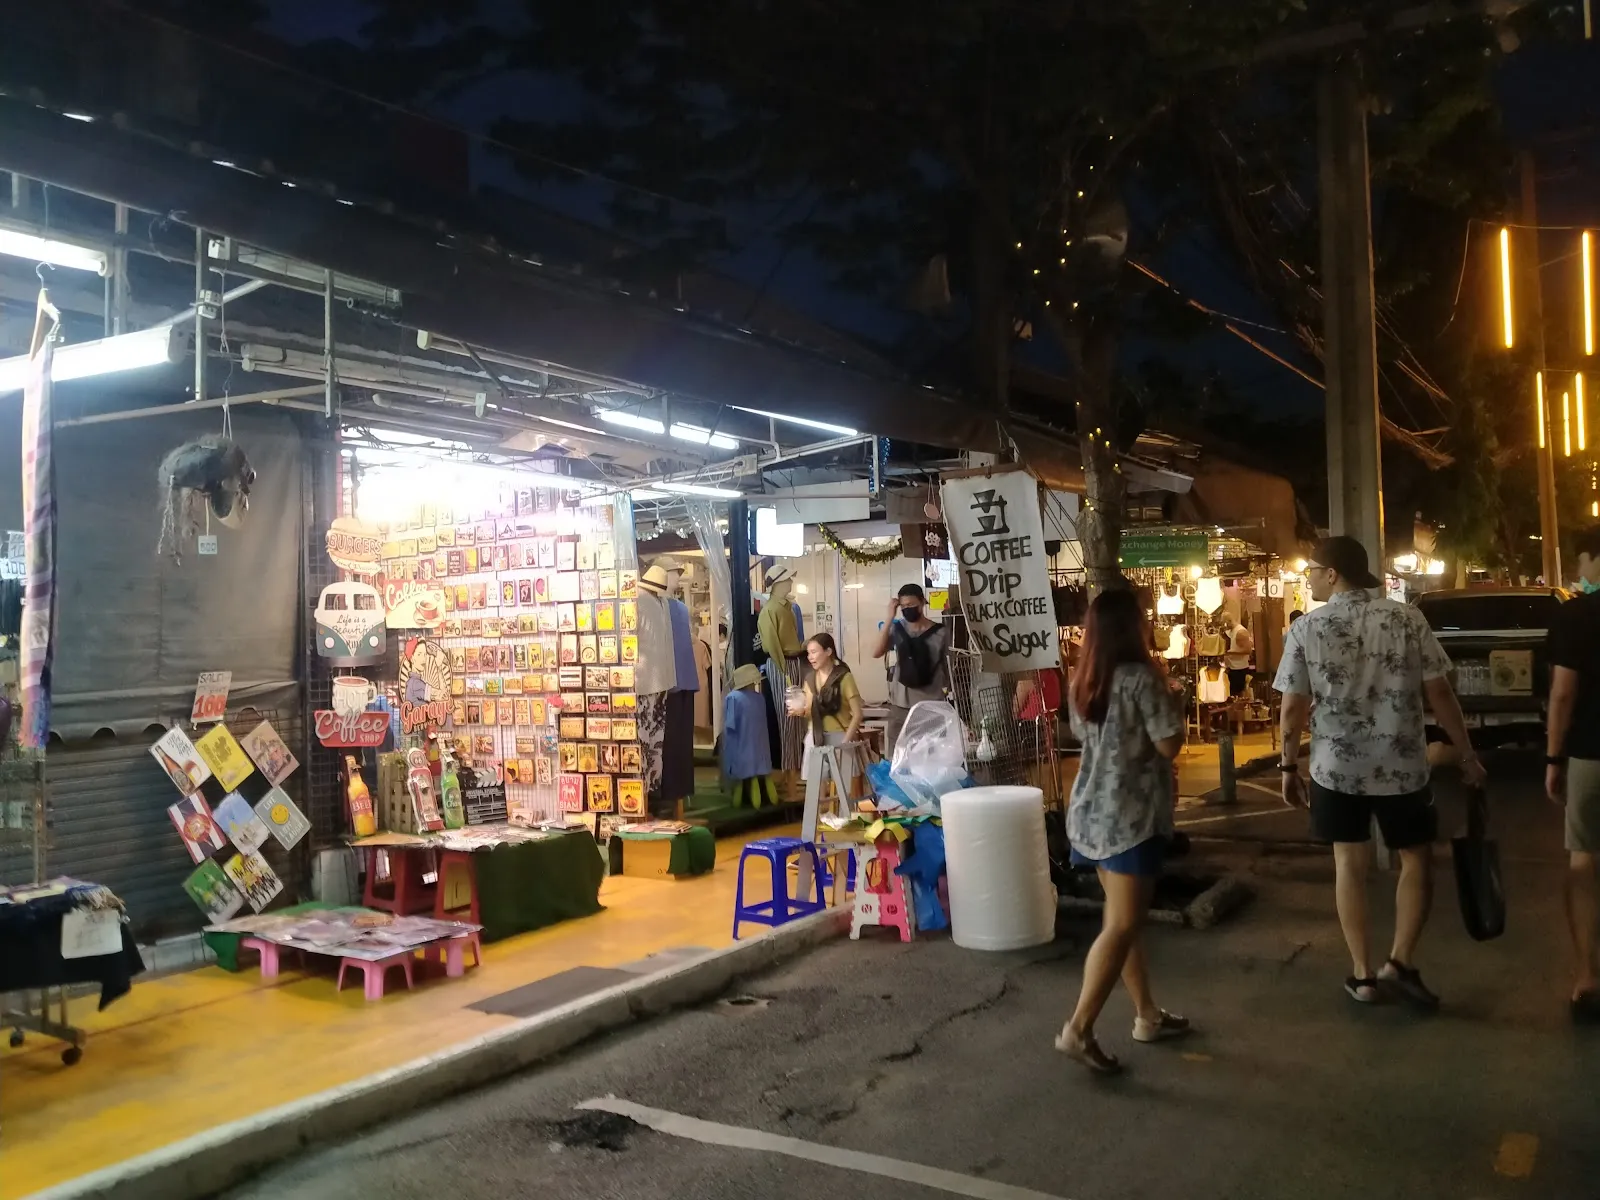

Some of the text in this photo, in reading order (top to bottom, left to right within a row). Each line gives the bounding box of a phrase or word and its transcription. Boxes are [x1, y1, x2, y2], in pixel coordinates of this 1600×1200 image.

[328, 533, 382, 556] BURGERS
[959, 535, 1033, 566] COFFEE
[1120, 539, 1204, 551] xchange Money
[385, 580, 428, 611] Coffee
[965, 567, 1022, 598] Drip
[337, 614, 352, 626] Life
[966, 596, 1048, 623] BLACK COFFEE
[971, 623, 1052, 658] No Sugar
[192, 694, 227, 719] 100
[401, 696, 455, 734] Garage
[314, 708, 387, 743] Coffee
[359, 733, 381, 743] SHOP
[560, 801, 579, 809] SIAM
